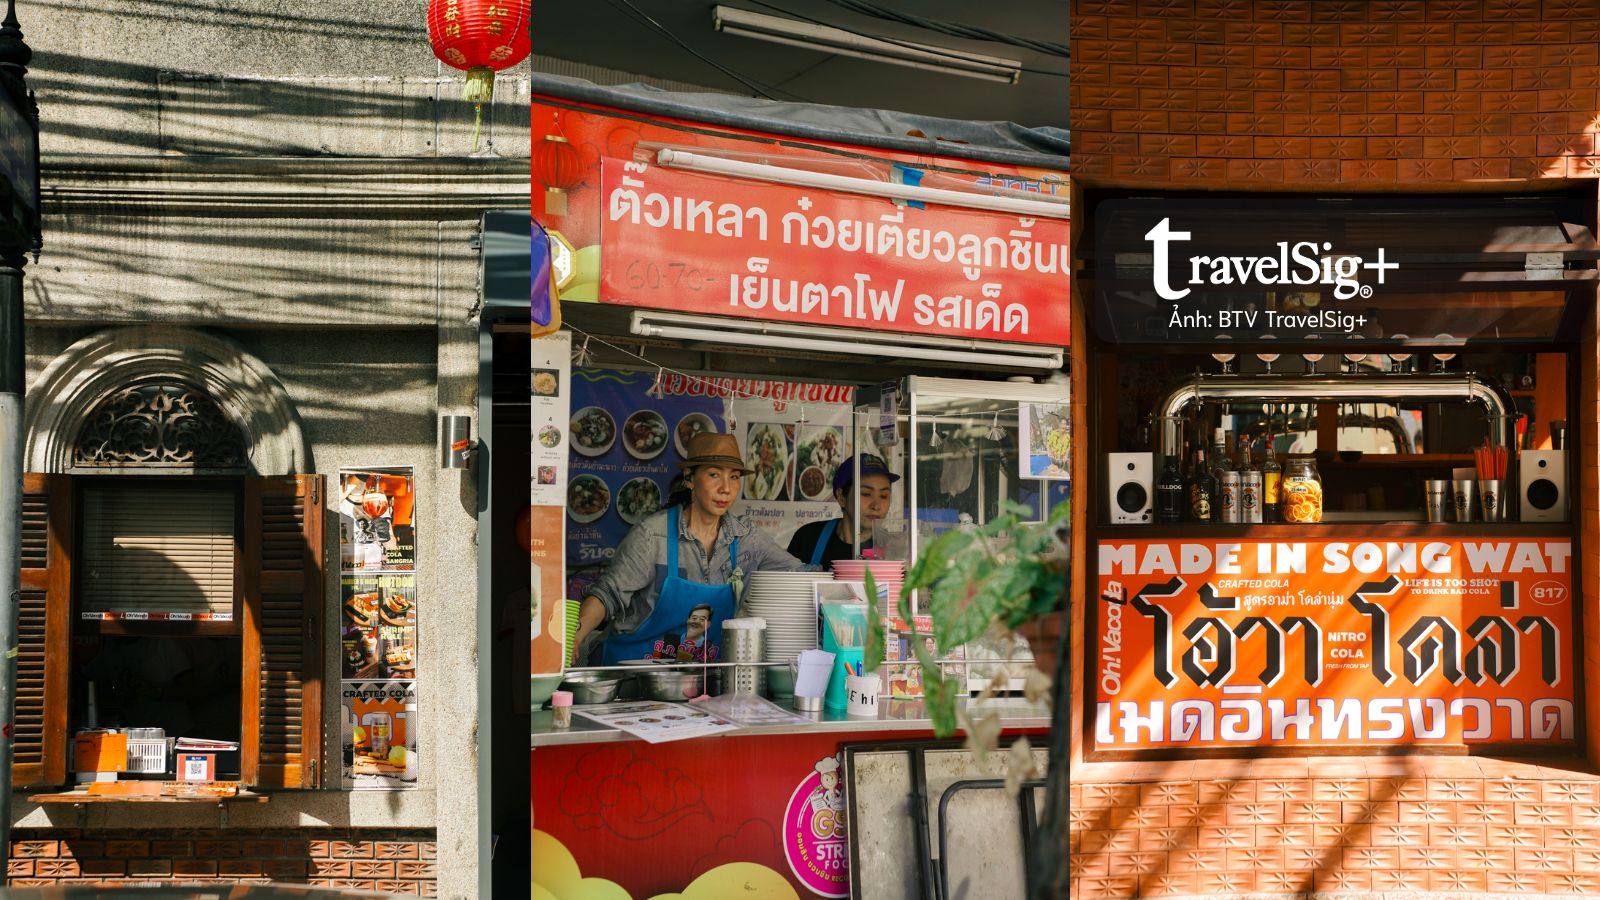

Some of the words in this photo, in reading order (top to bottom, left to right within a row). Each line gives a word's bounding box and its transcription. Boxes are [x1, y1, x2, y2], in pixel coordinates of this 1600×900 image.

[730, 257, 906, 322] เย็นตาโฟ
[913, 283, 1029, 335] รสเด็ด
[1098, 543, 1242, 575] MADE
[1257, 543, 1307, 574] IN
[1323, 542, 1452, 574] SONG
[1462, 542, 1572, 574] WAT
[1218, 579, 1262, 588] CRAFTED
[1264, 579, 1290, 588] COLA
[1405, 579, 1430, 587] LIFE
[1431, 579, 1443, 587] IS
[1445, 579, 1467, 587] TOO
[1470, 579, 1499, 587] SHOT
[1243, 591, 1295, 611] สูตรอาม่า
[1534, 588, 1564, 599] 817
[1348, 575, 1562, 688] โคล่า
[1330, 649, 1364, 659] COLA
[1102, 654, 1122, 696] Oh!
[343, 690, 387, 698] CRAFTED
[389, 690, 414, 698] COLA
[811, 808, 848, 840] GS
